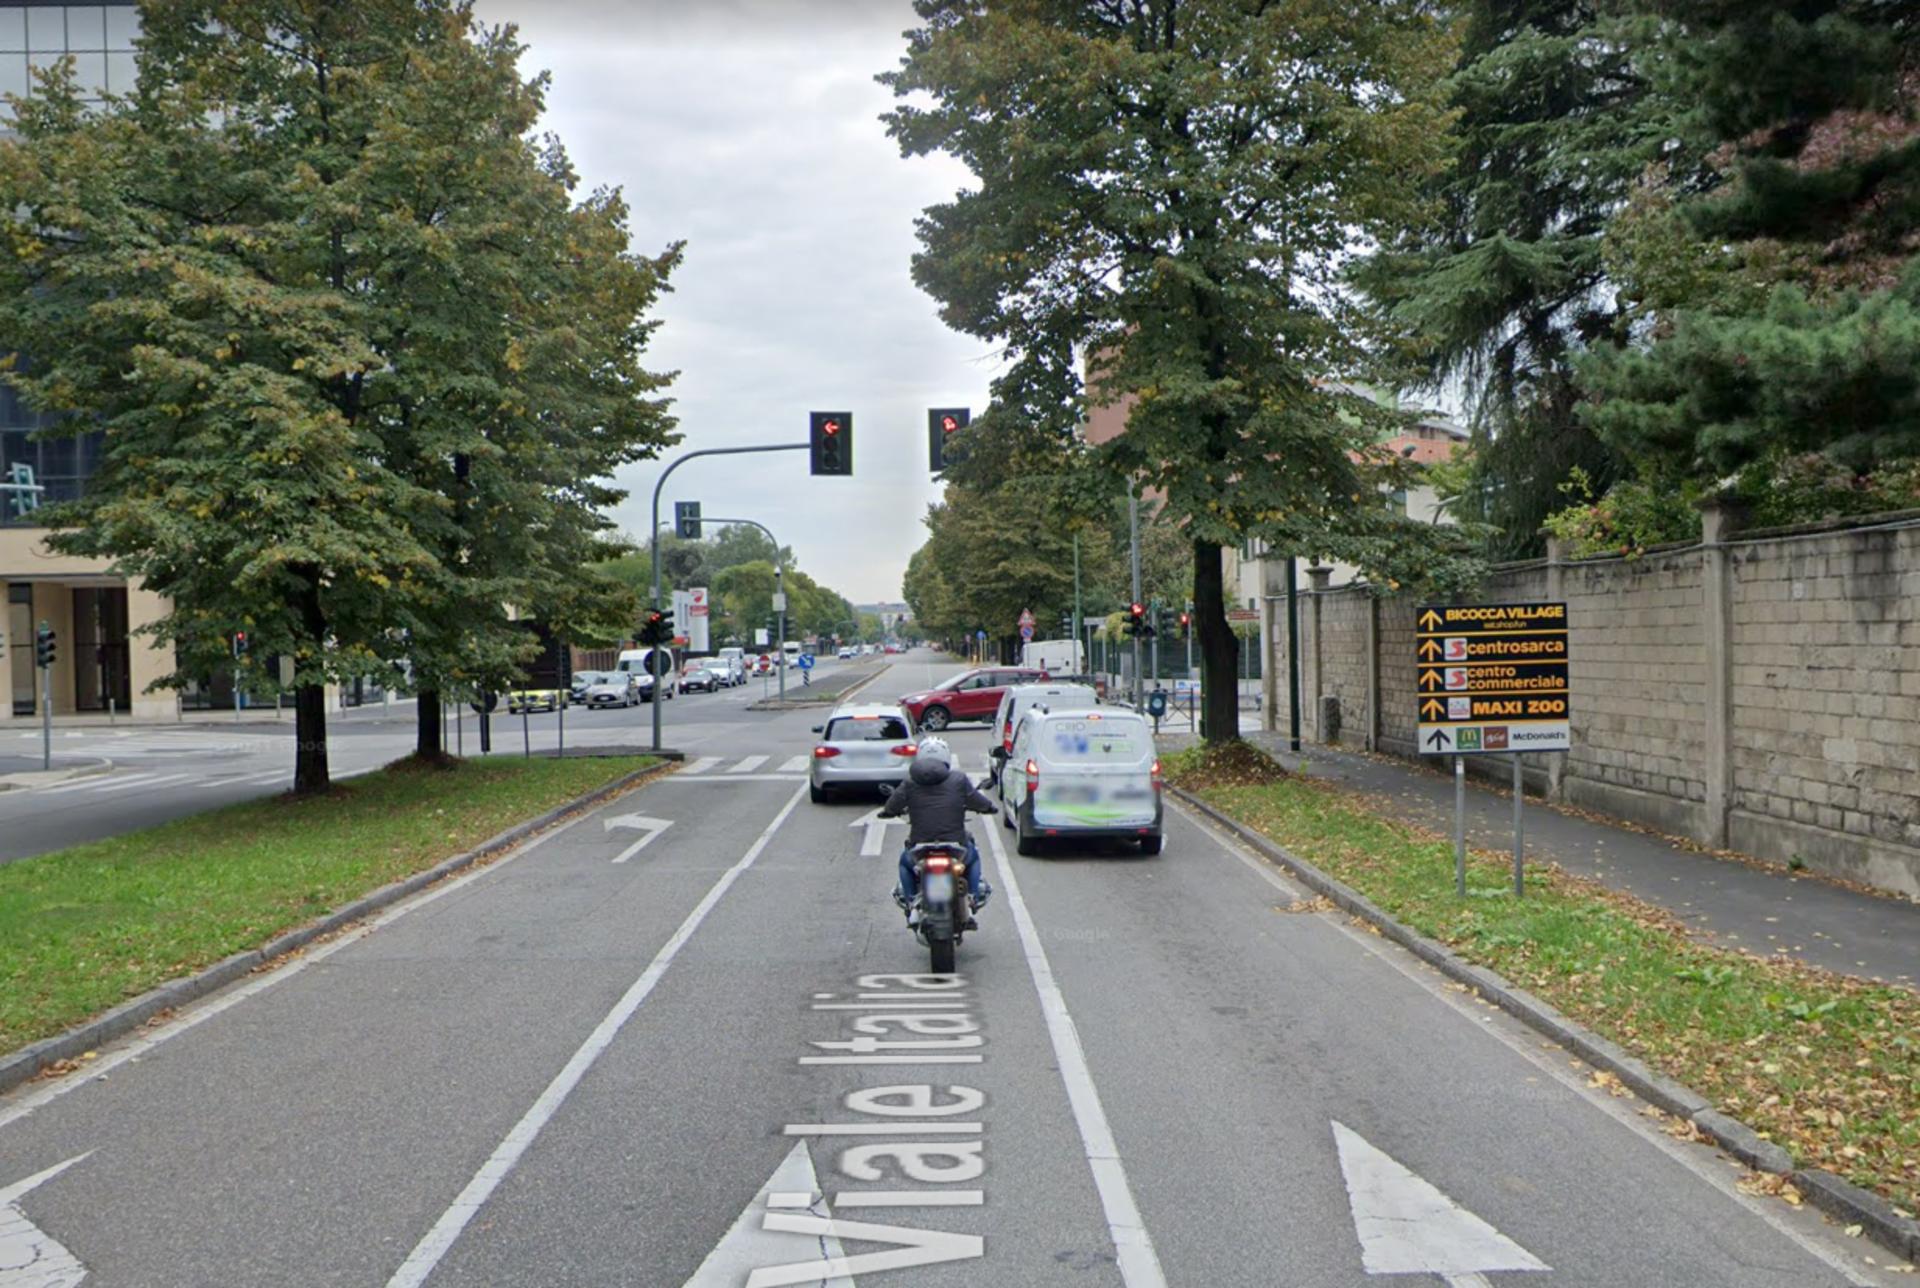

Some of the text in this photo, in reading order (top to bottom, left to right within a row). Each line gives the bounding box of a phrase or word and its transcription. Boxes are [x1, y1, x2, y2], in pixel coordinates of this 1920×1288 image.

[1446, 606, 1564, 621] BICOCCA VILLAGE
[1467, 640, 1564, 654] centrosarca
[1467, 666, 1516, 678] centro
[1467, 675, 1565, 689] commerciale
[1473, 701, 1522, 715] MAXI
[1528, 700, 1565, 714] ZOO
